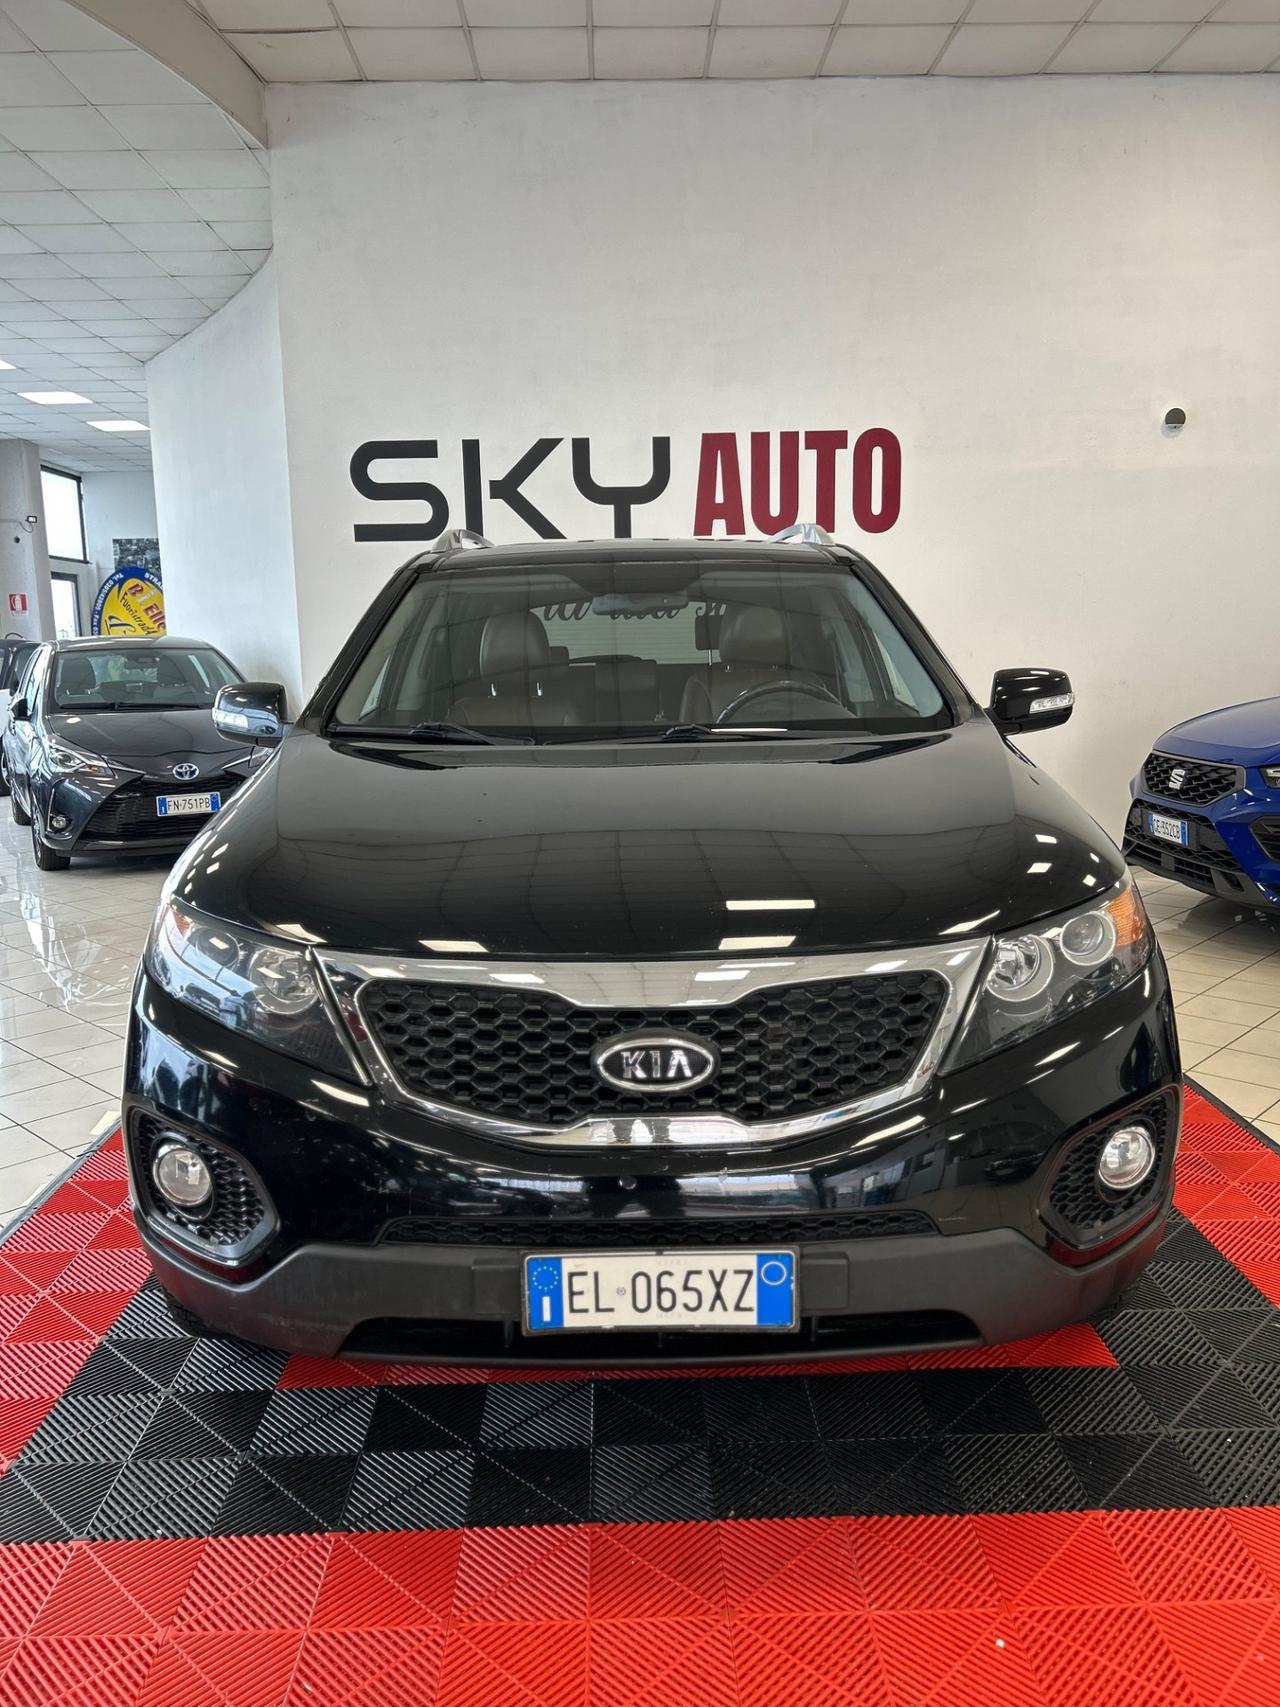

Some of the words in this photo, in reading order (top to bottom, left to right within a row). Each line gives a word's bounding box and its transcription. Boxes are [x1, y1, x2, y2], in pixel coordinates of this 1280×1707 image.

[350, 436, 671, 541] SKY
[693, 428, 902, 537] AUTO
[620, 1049, 692, 1079] KIA
[567, 1271, 615, 1314] EL
[631, 1269, 754, 1314] 065XZ
